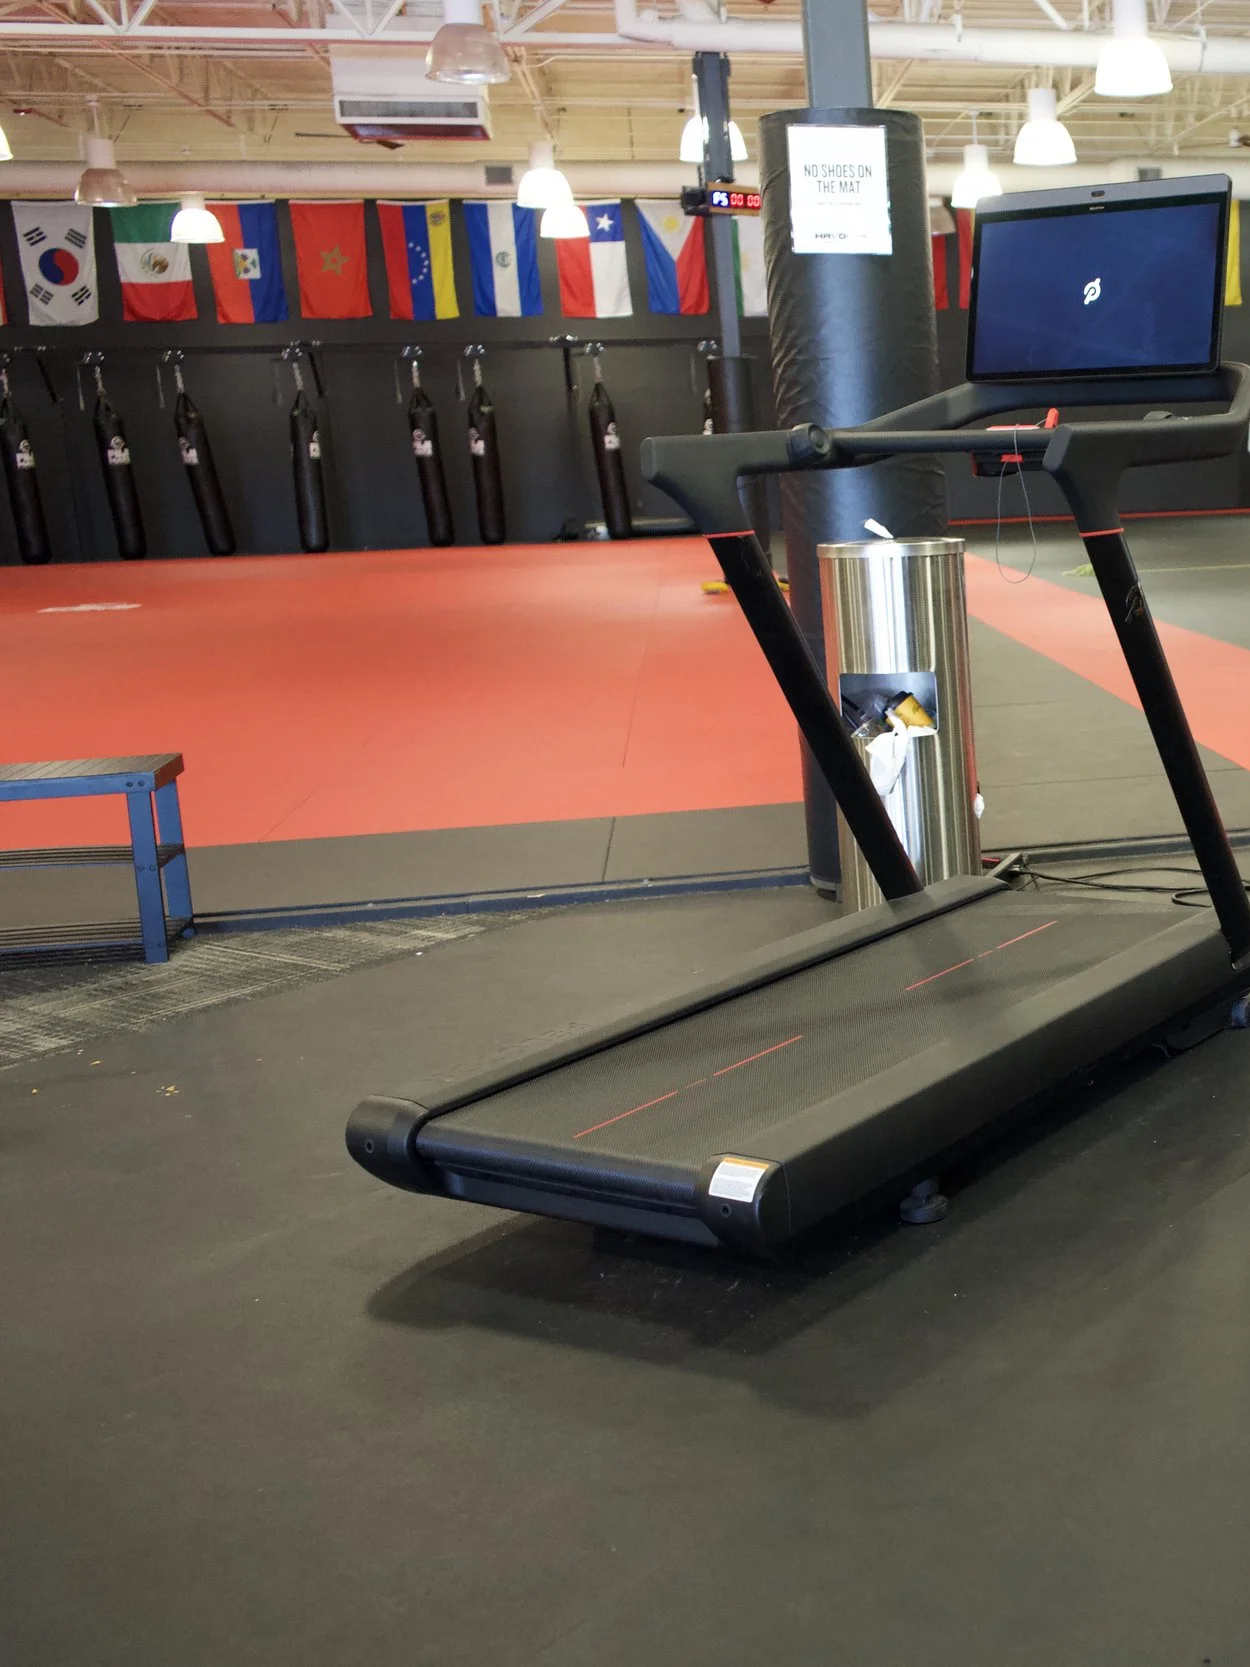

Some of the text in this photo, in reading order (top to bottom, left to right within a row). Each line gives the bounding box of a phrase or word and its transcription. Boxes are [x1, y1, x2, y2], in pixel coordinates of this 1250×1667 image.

[804, 164, 872, 179] NO SHOES ON
[817, 180, 861, 194] THE MAT
